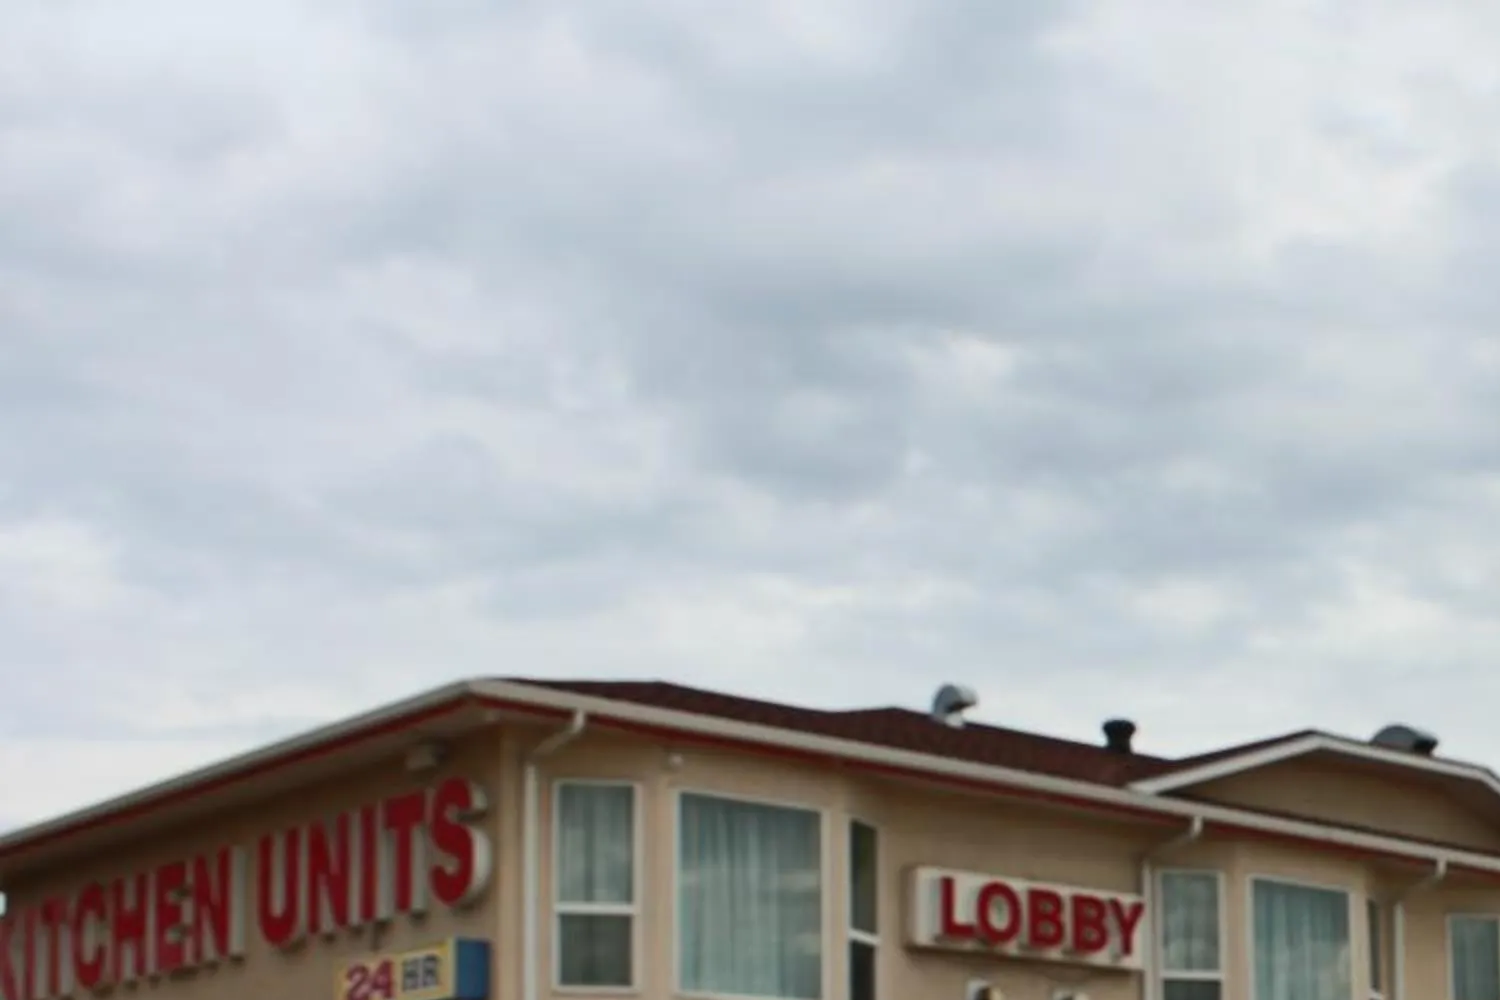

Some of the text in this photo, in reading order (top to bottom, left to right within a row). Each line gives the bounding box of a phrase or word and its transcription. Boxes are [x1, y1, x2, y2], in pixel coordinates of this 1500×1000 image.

[257, 776, 482, 950] UNITS
[938, 876, 1145, 957] LOBBY
[402, 955, 440, 992] HR
